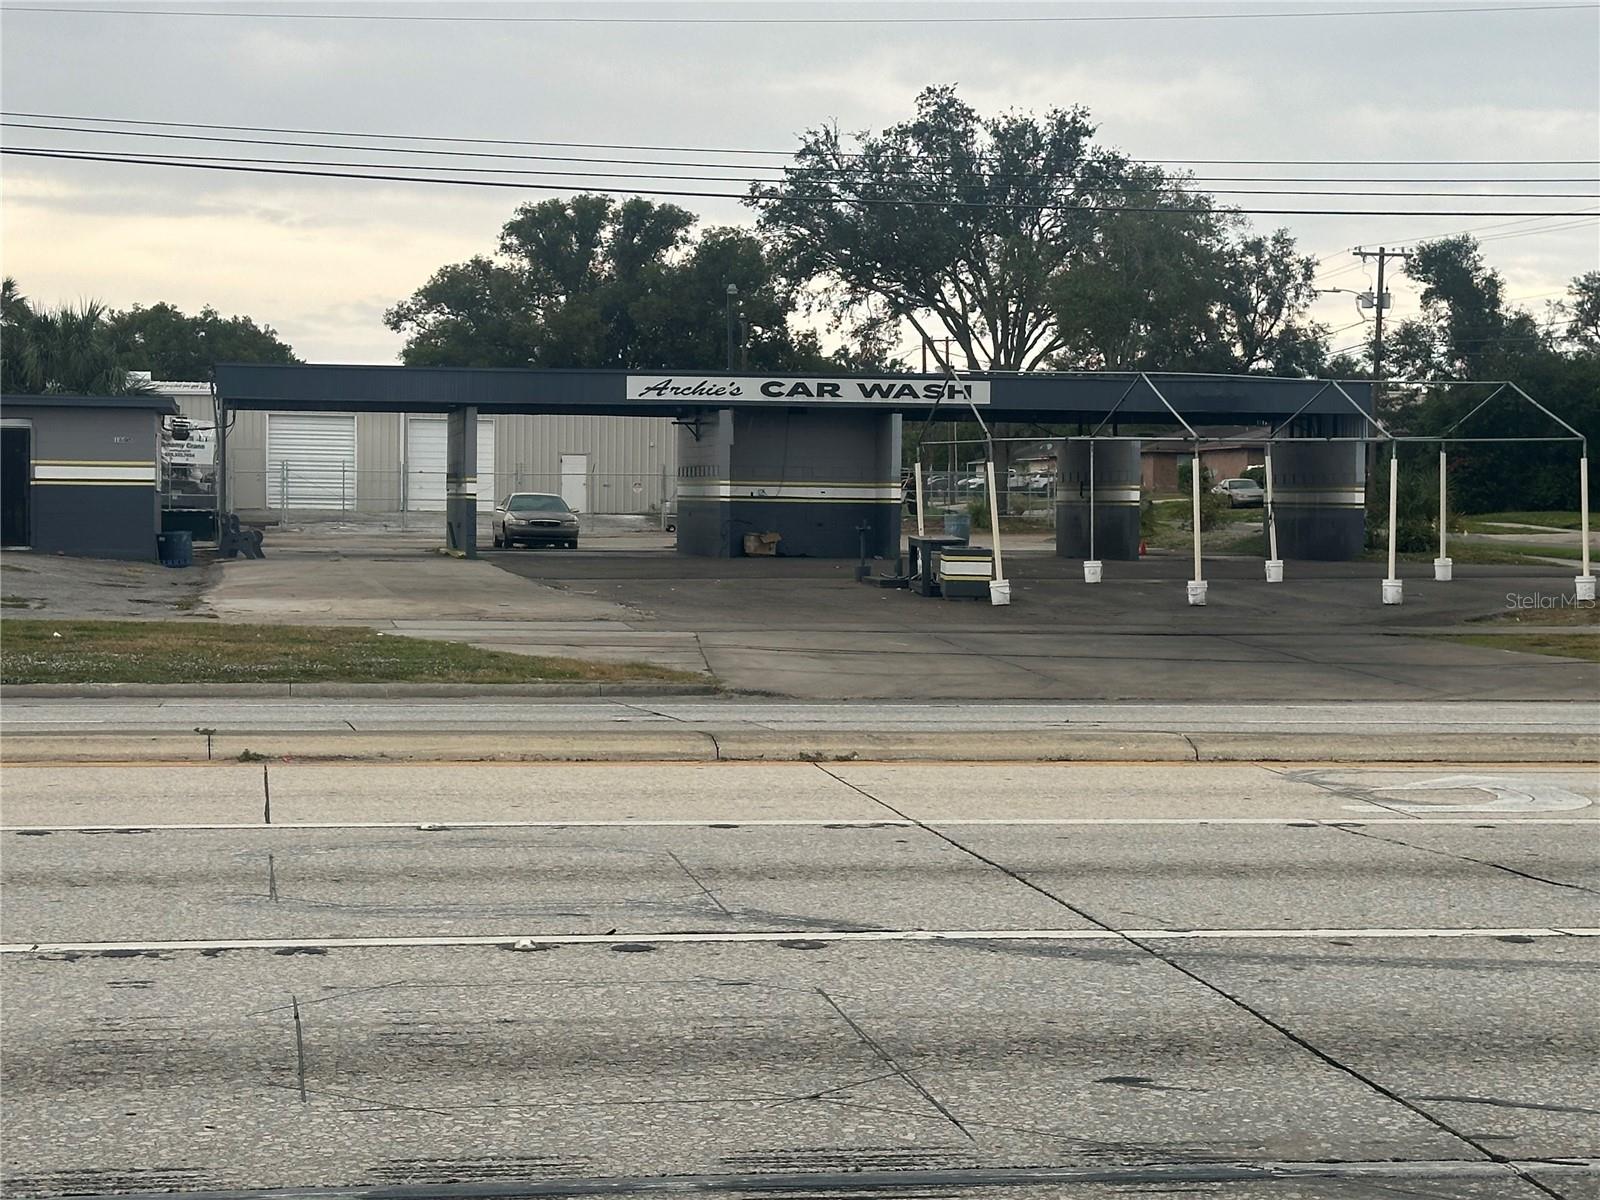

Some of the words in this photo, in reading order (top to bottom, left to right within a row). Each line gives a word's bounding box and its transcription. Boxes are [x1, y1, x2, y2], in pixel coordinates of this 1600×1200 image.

[638, 379, 743, 397] Archie's
[760, 381, 842, 397] CAR
[856, 383, 972, 400] WASH
